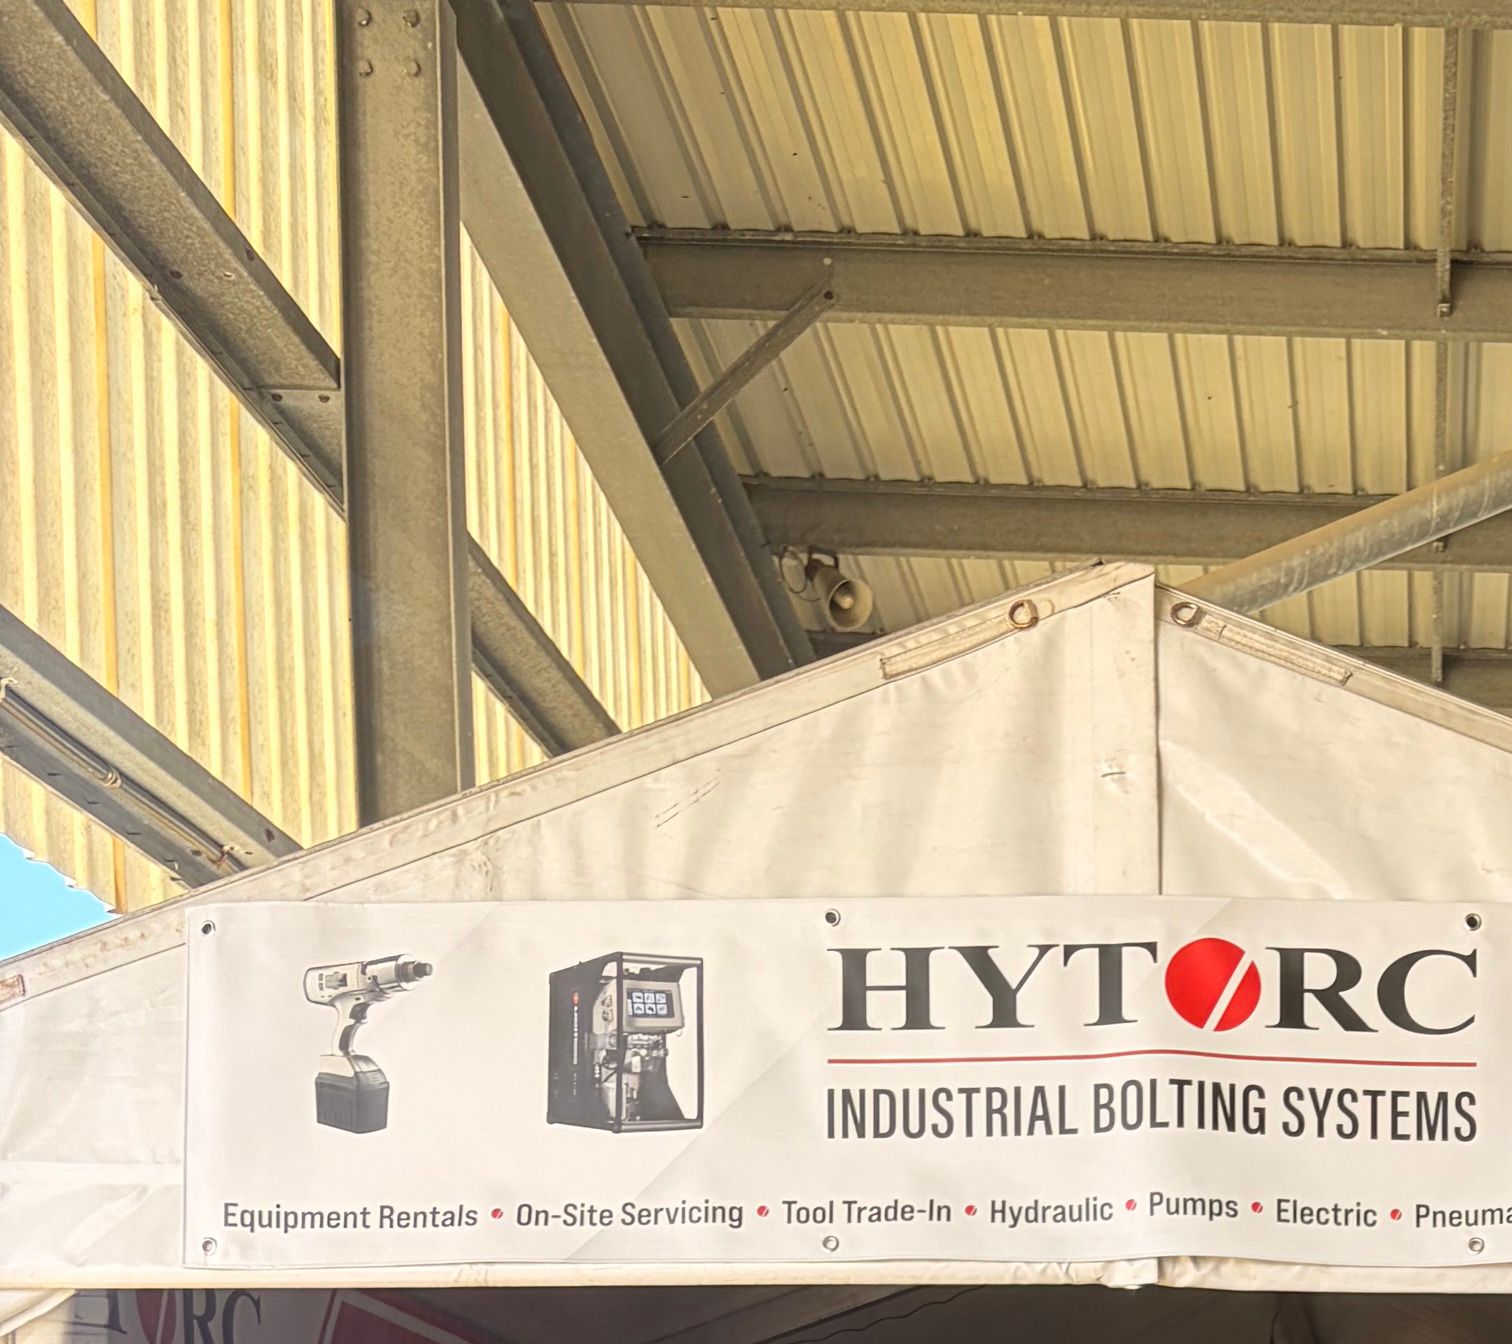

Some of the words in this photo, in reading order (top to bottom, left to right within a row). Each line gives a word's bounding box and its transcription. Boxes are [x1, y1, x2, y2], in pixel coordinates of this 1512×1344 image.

[826, 937, 1478, 1035] HYTORC
[826, 1085, 1079, 1140] INDUSTRIAL
[1093, 1078, 1267, 1135] BOLTING
[1281, 1086, 1478, 1142] SYSTEMS
[223, 1202, 371, 1231] Equipment
[379, 1204, 479, 1229] Rentals
[516, 1202, 614, 1227] On-Site
[621, 1199, 744, 1229] Servicing
[782, 1199, 834, 1225] Tool
[843, 1199, 952, 1224] Trade-In
[990, 1197, 1114, 1227] Hydraulic
[1149, 1192, 1239, 1221] Pumps
[1276, 1199, 1377, 1228] Electric
